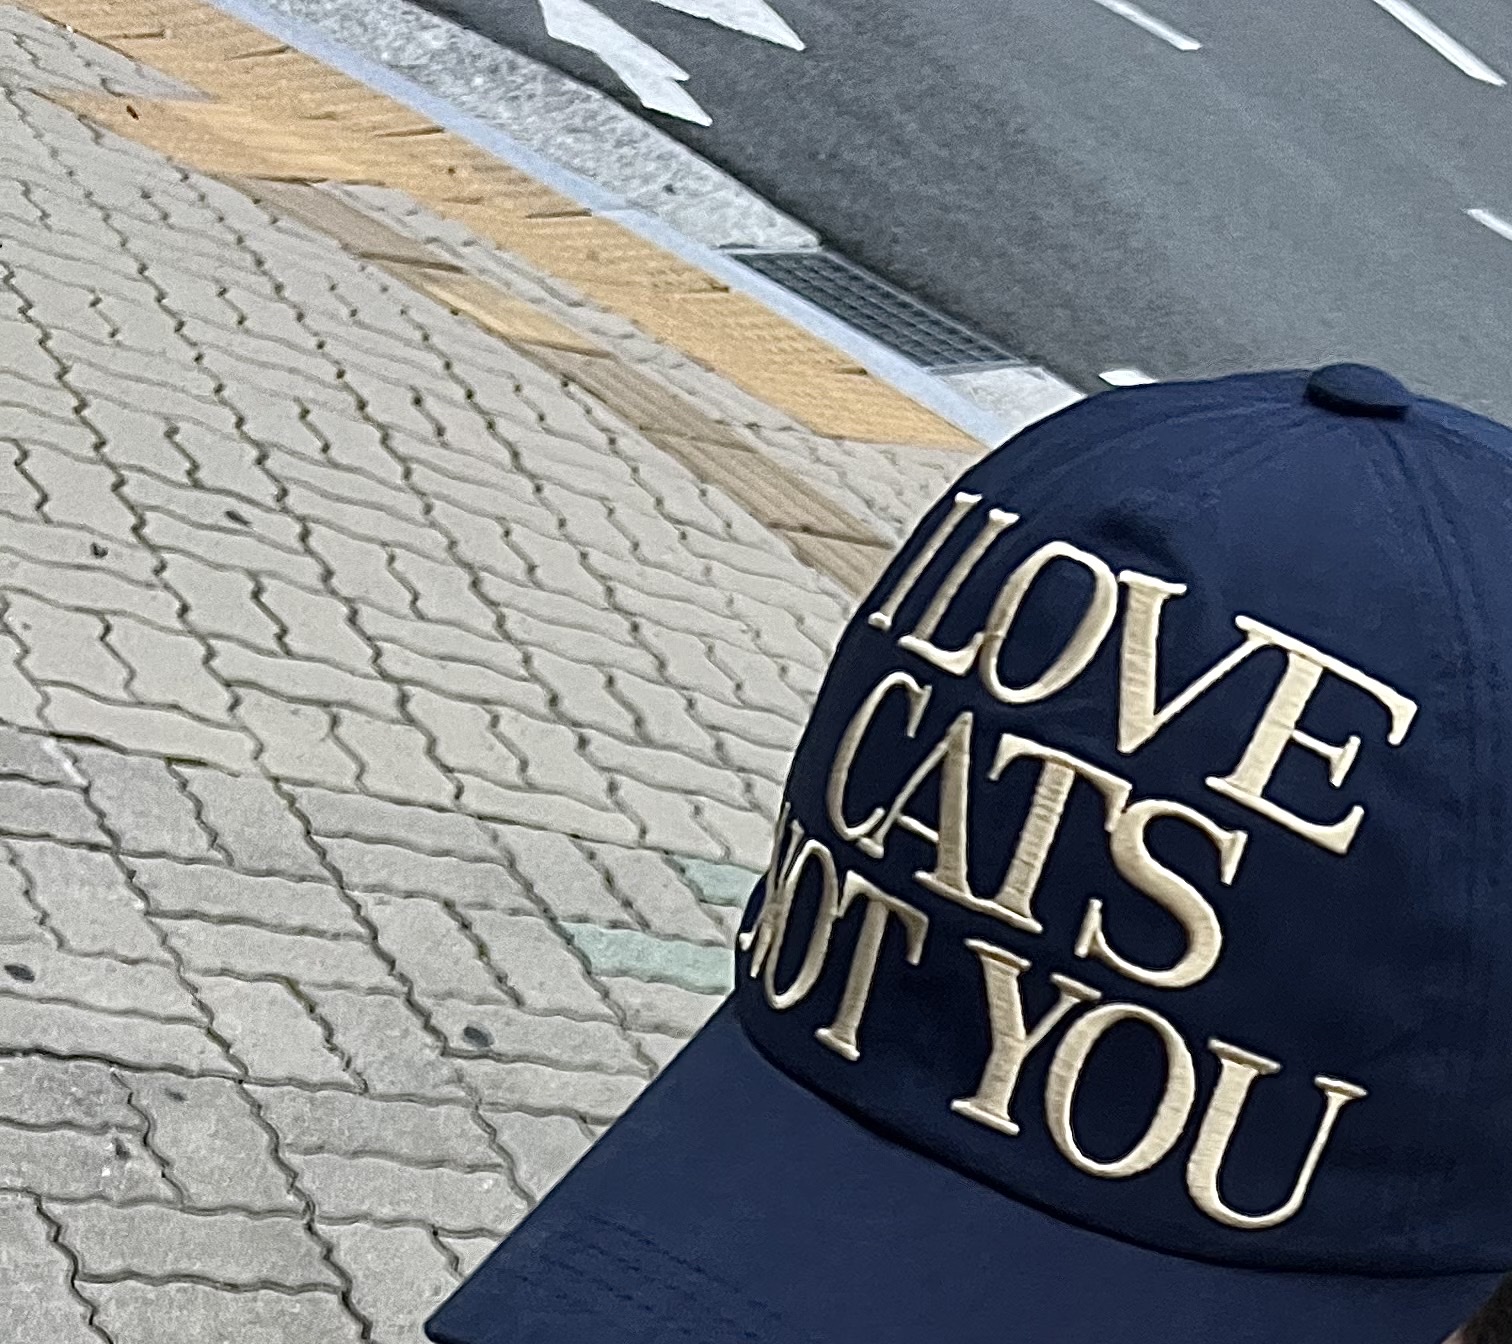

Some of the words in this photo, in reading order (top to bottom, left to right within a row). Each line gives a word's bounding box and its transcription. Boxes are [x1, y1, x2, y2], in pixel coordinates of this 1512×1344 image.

[867, 491, 983, 631] I
[897, 507, 1418, 855] LOVE
[826, 671, 1249, 989] CATS
[950, 939, 1367, 1230] YOU
